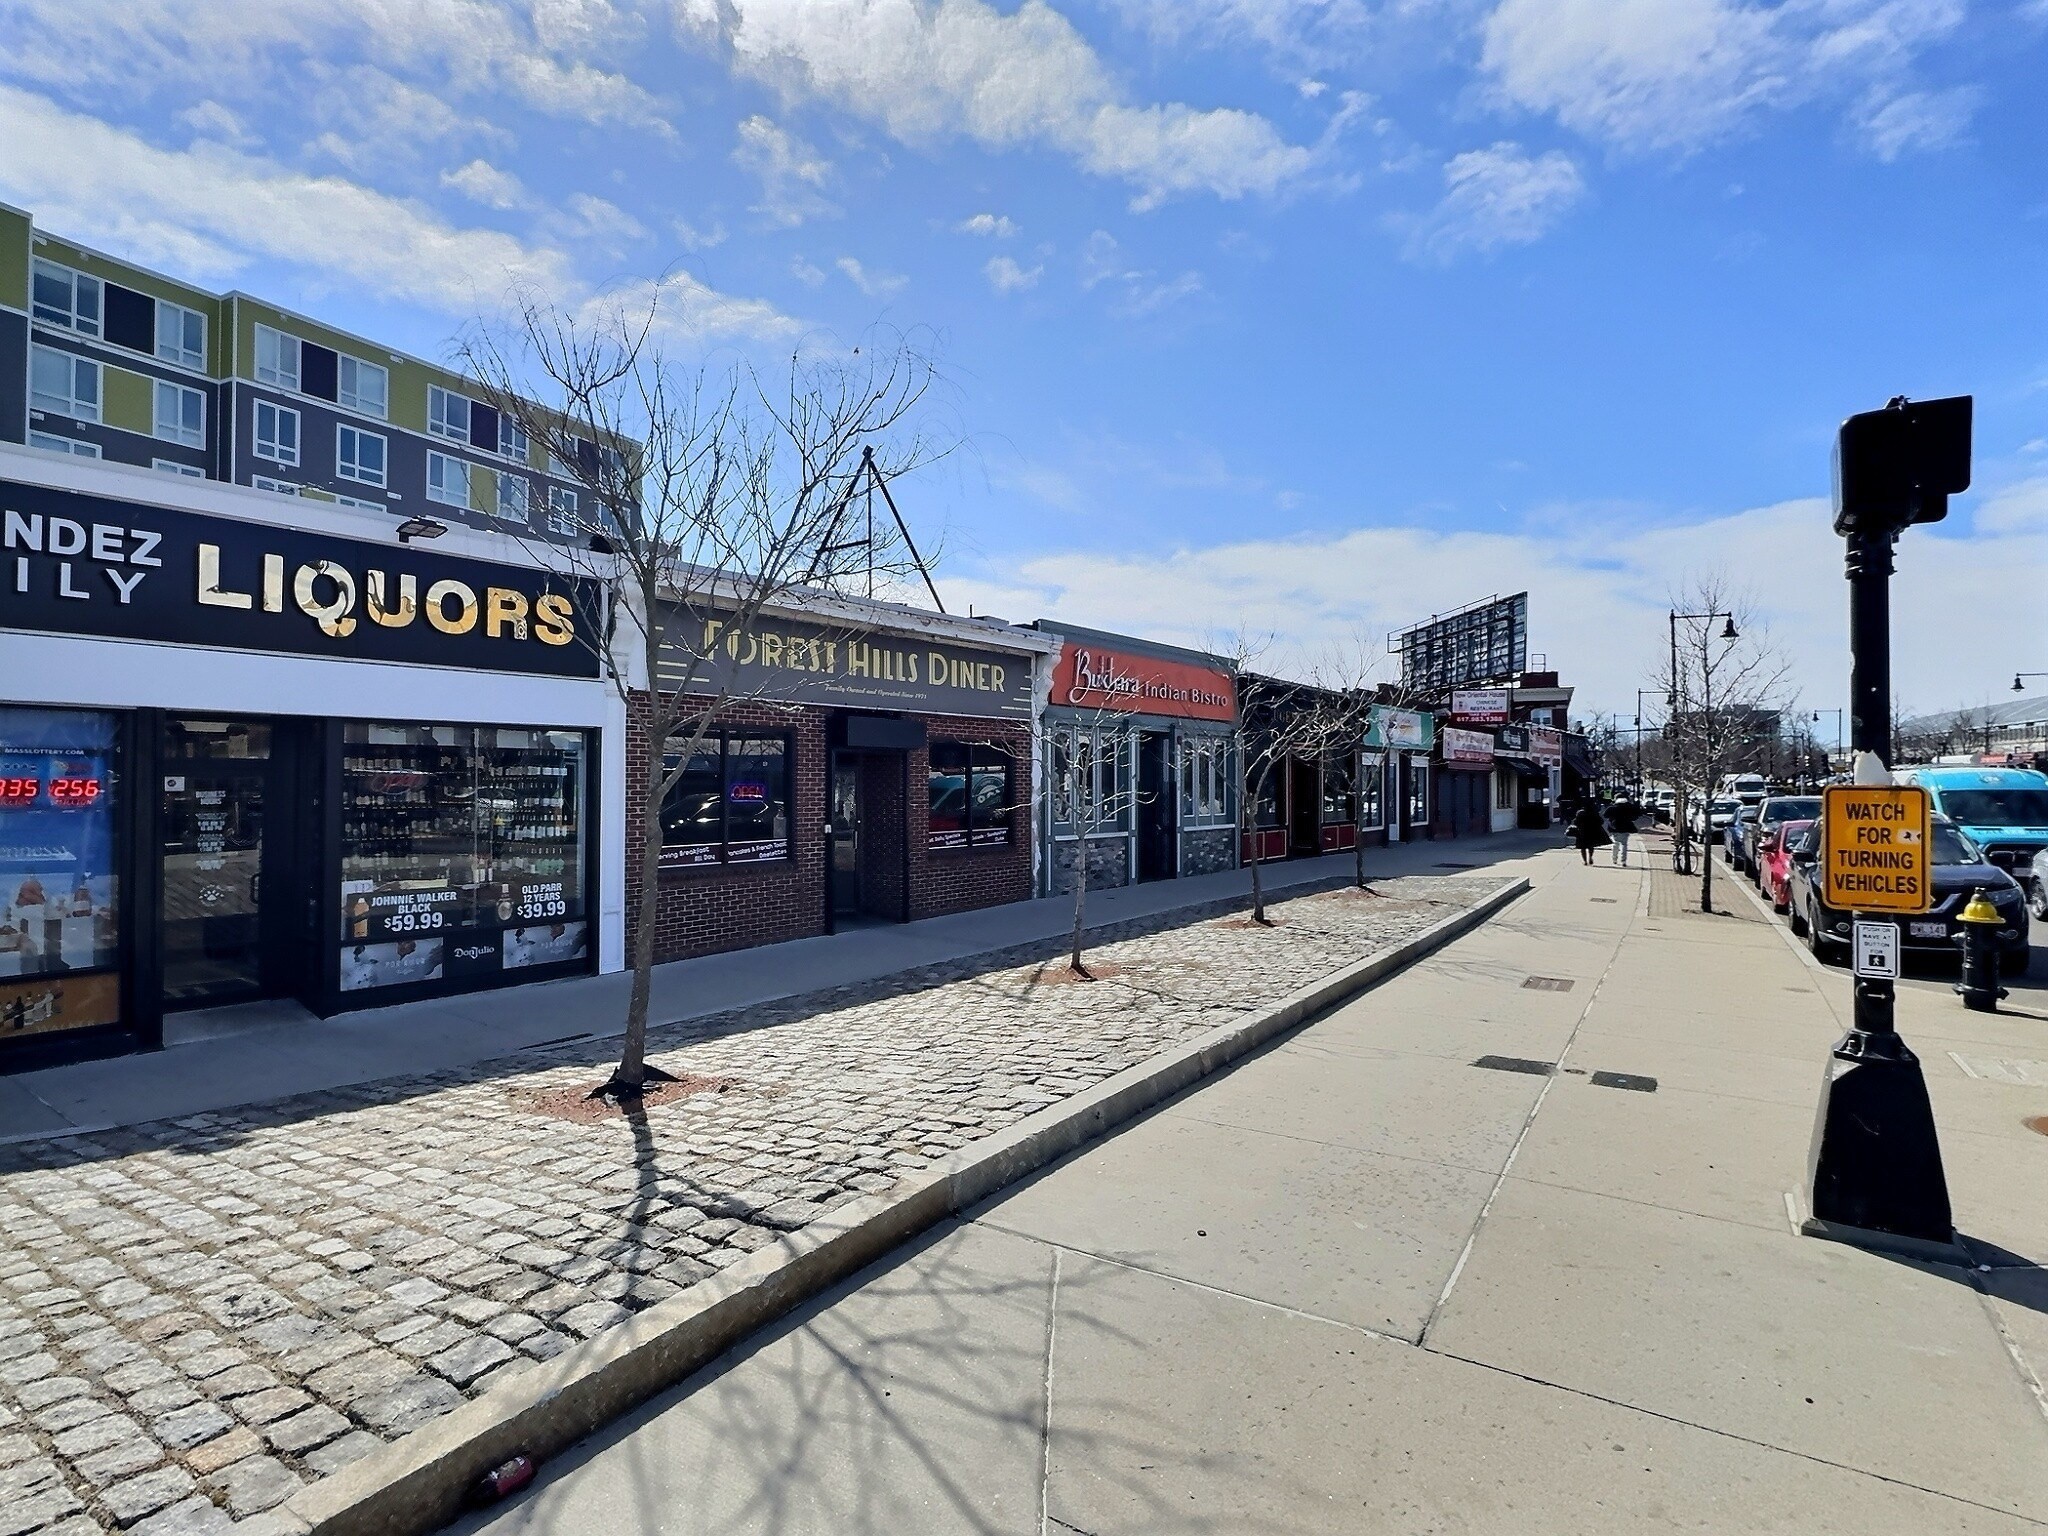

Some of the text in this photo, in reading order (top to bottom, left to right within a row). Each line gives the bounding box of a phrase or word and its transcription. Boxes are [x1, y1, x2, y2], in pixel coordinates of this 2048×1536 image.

[4, 509, 162, 567] NDEZ
[17, 557, 146, 604] ILY
[198, 543, 575, 645] LIQUORS
[704, 620, 1005, 693] FOREST HILLS DINER
[1069, 648, 1228, 707] Bukhara Indian Bistro
[54, 779, 98, 797] 256
[1845, 802, 1905, 821] WATCH
[1857, 826, 1892, 845] FOR
[658, 847, 709, 860] erving Breakfast
[1837, 849, 1914, 870] TURNING
[521, 882, 562, 894] OLD PARR
[1833, 872, 1918, 895] VEHICLES
[371, 891, 457, 907] JOHNNIE WALKER
[523, 892, 561, 903] 12 YEARS
[398, 903, 431, 914] BLACK
[517, 901, 566, 919] $39.99
[384, 911, 443, 932] $59.99
